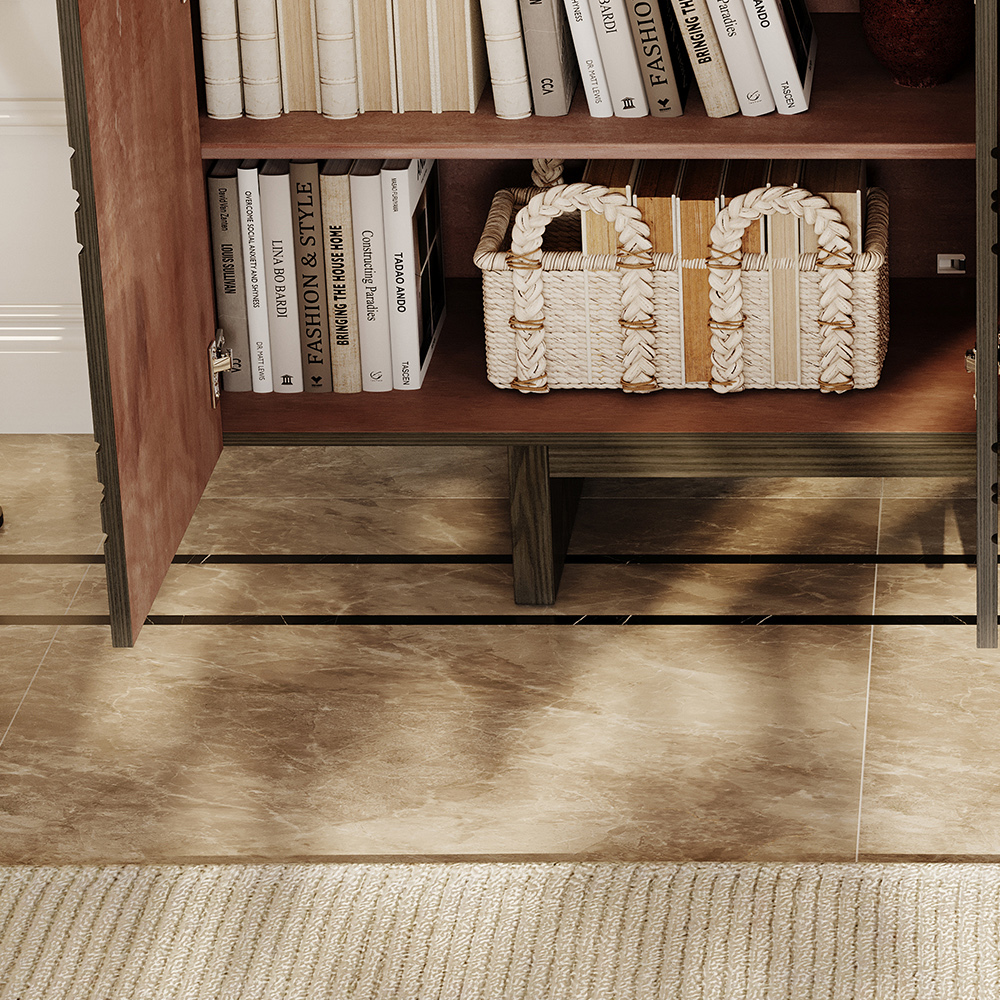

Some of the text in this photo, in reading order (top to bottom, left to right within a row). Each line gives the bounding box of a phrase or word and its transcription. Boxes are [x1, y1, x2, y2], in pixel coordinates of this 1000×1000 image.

[753, 0, 770, 28] ANDO
[685, 16, 712, 64] BRINGING
[589, 70, 598, 86] MATT
[592, 86, 602, 104] LEWIS
[780, 80, 795, 108] TASCEN
[245, 191, 254, 222] OVERCOME
[221, 244, 236, 294] LOUIS SULLIVAN
[249, 244, 257, 270] ANXIETY
[272, 240, 288, 318] LINA BO BARDI
[296, 182, 324, 364] FASHION & STYLE
[329, 225, 350, 346] BRINGING THE HOUSE HOME
[362, 230, 378, 322] Constructing Paradies
[394, 252, 406, 313] TADAO ANDO
[252, 284, 260, 308] SHYNESS
[258, 366, 266, 380] LEWIS
[402, 362, 410, 386] TASCEN
